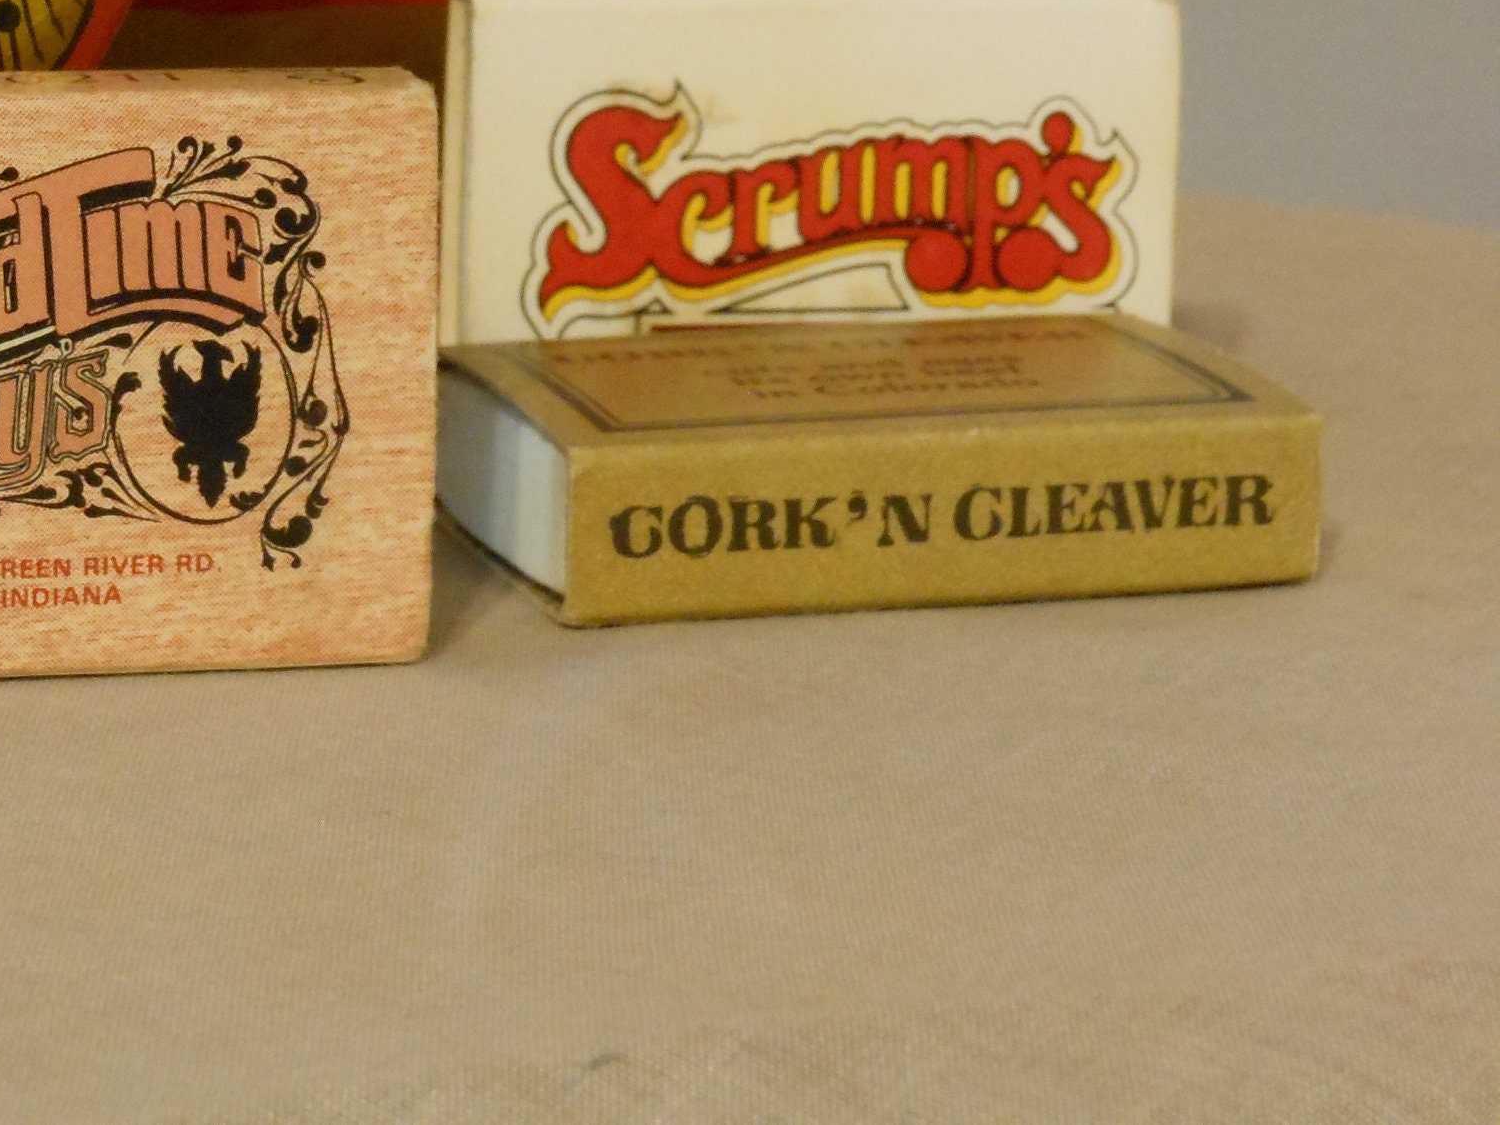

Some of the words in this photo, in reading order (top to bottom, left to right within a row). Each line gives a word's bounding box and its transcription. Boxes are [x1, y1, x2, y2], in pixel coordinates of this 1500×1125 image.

[538, 103, 1122, 321] Scrump's
[953, 473, 1275, 543] CLEAVER
[83, 553, 165, 577] RIVER
[176, 552, 224, 575] RD.
[0, 583, 124, 610] INDIANA
